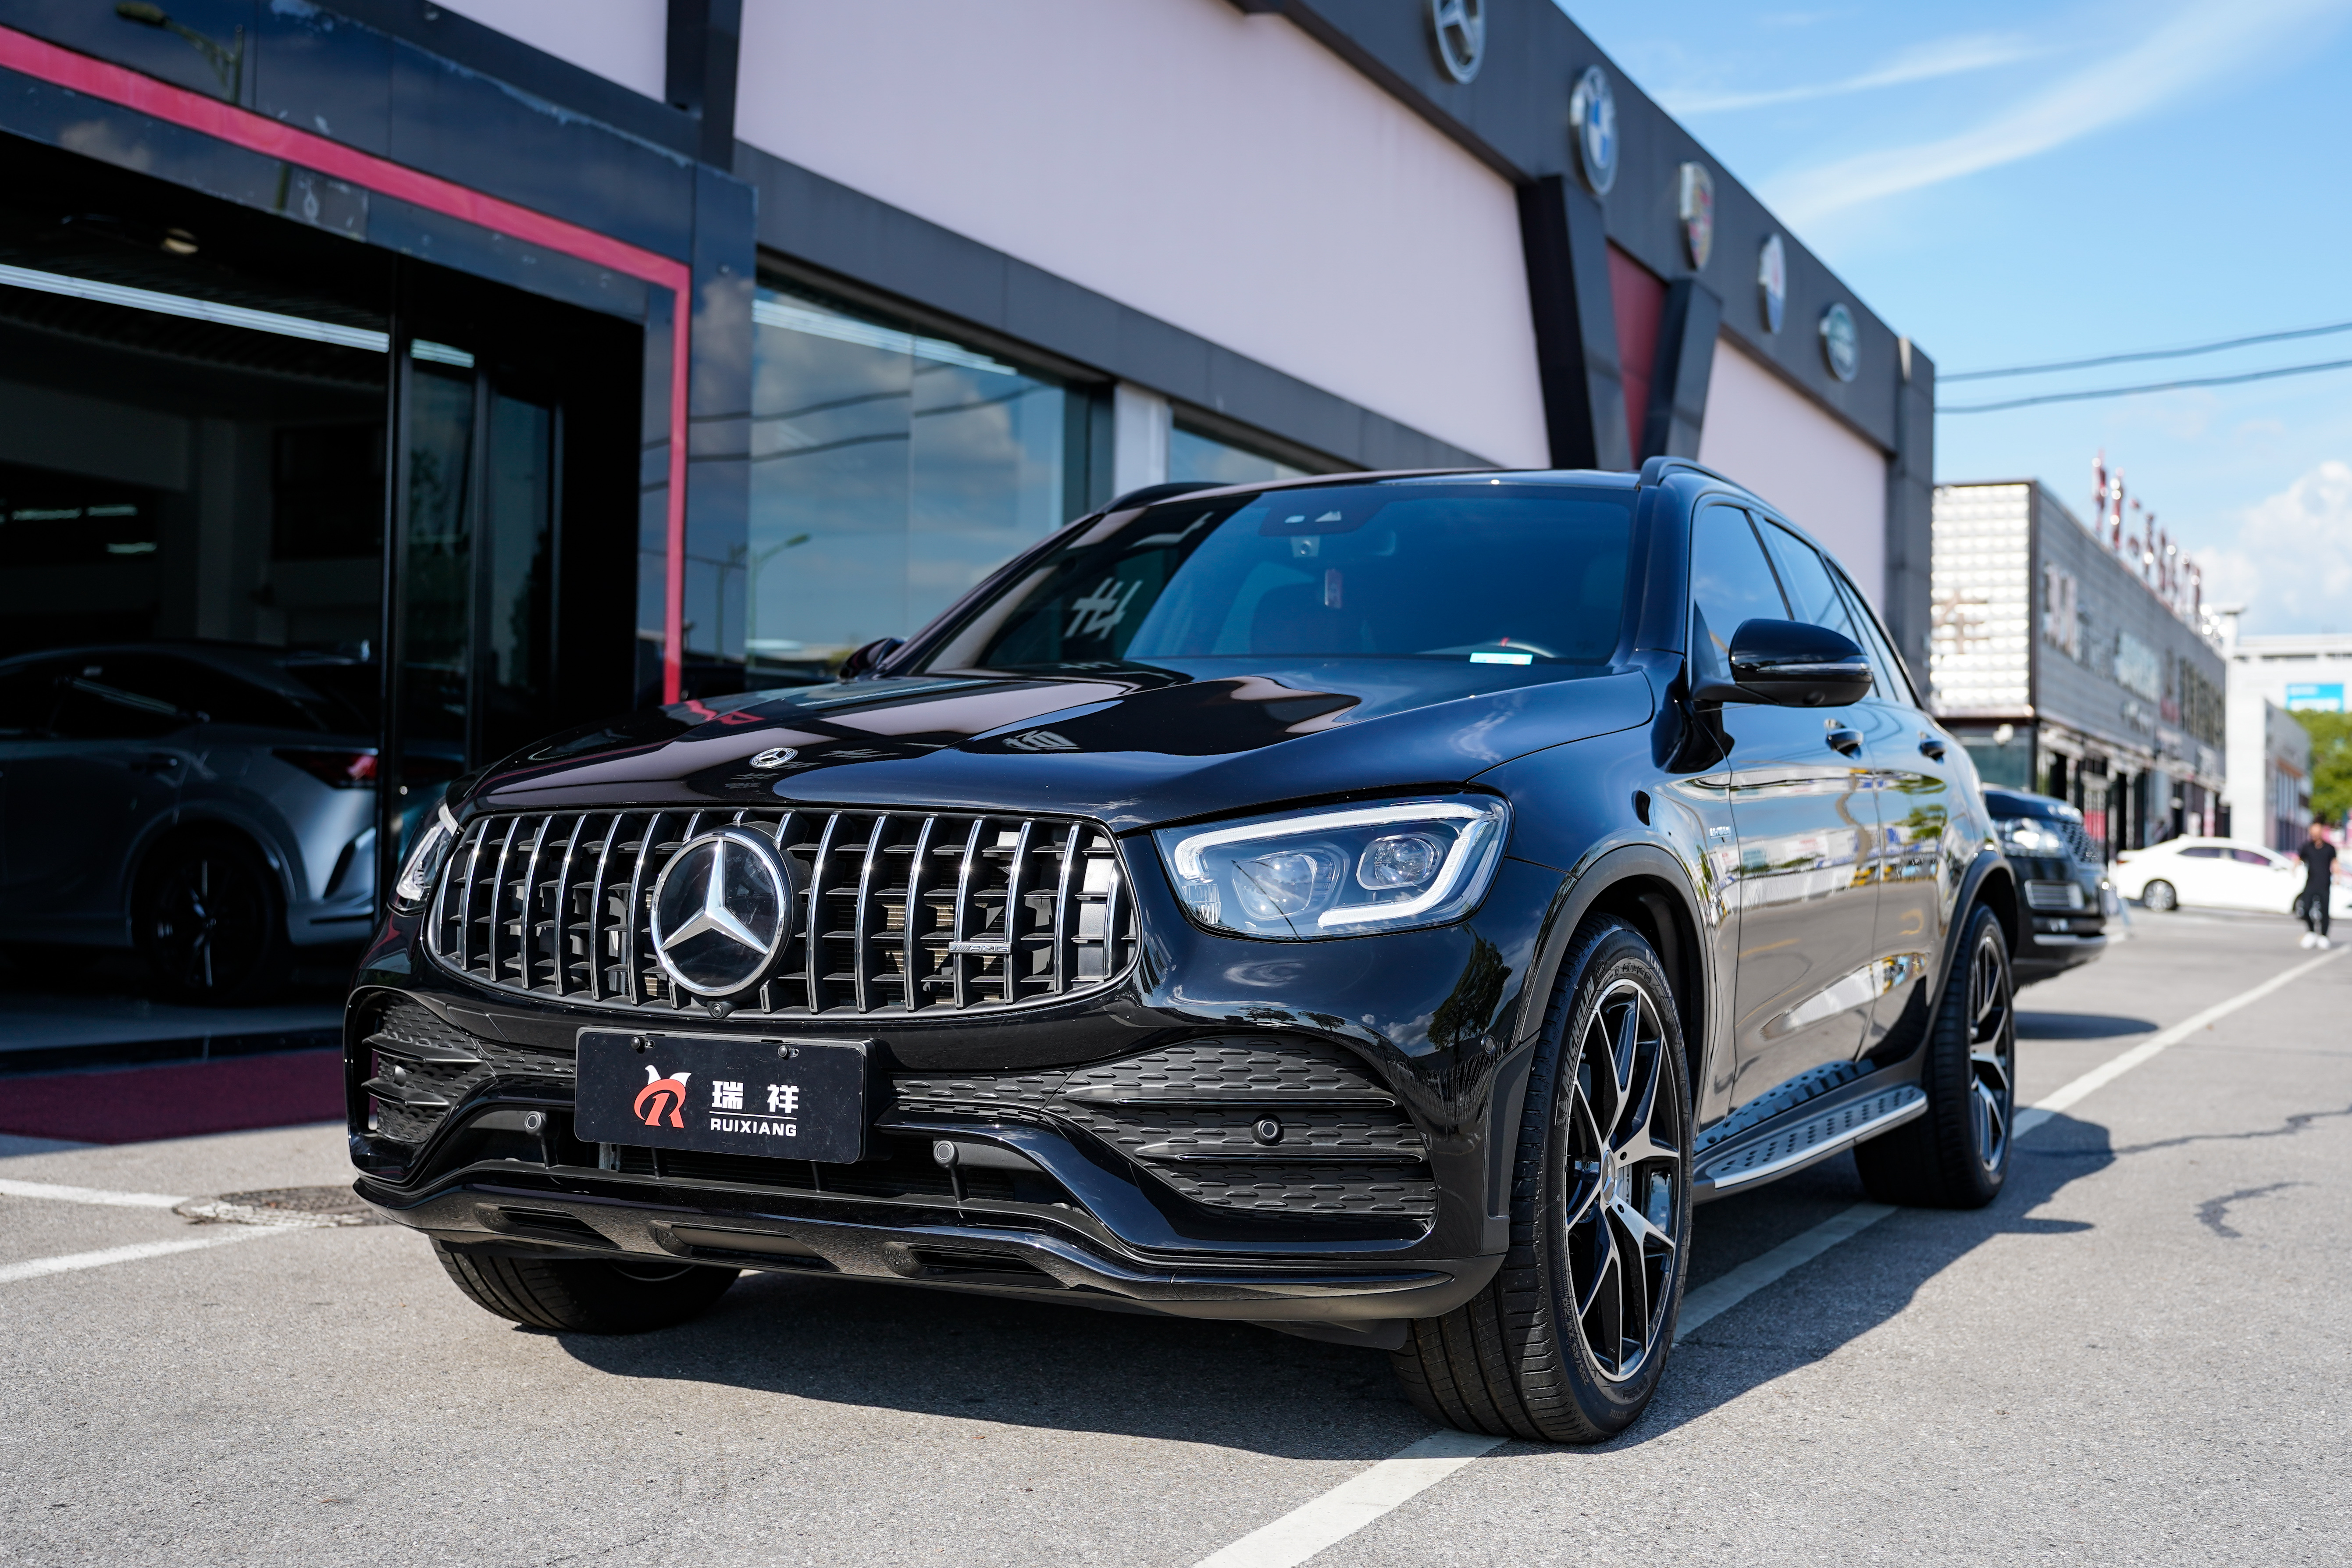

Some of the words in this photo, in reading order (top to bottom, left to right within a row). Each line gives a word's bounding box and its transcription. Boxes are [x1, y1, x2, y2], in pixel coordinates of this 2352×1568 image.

[1650, 955, 1672, 1000] LATITUDE
[1561, 975, 1595, 1094] MICHELIN
[711, 1080, 799, 1114] 瑞祥
[710, 1118, 797, 1137] RUIXIANG
[1609, 1408, 1628, 1419] OUTSIDE
